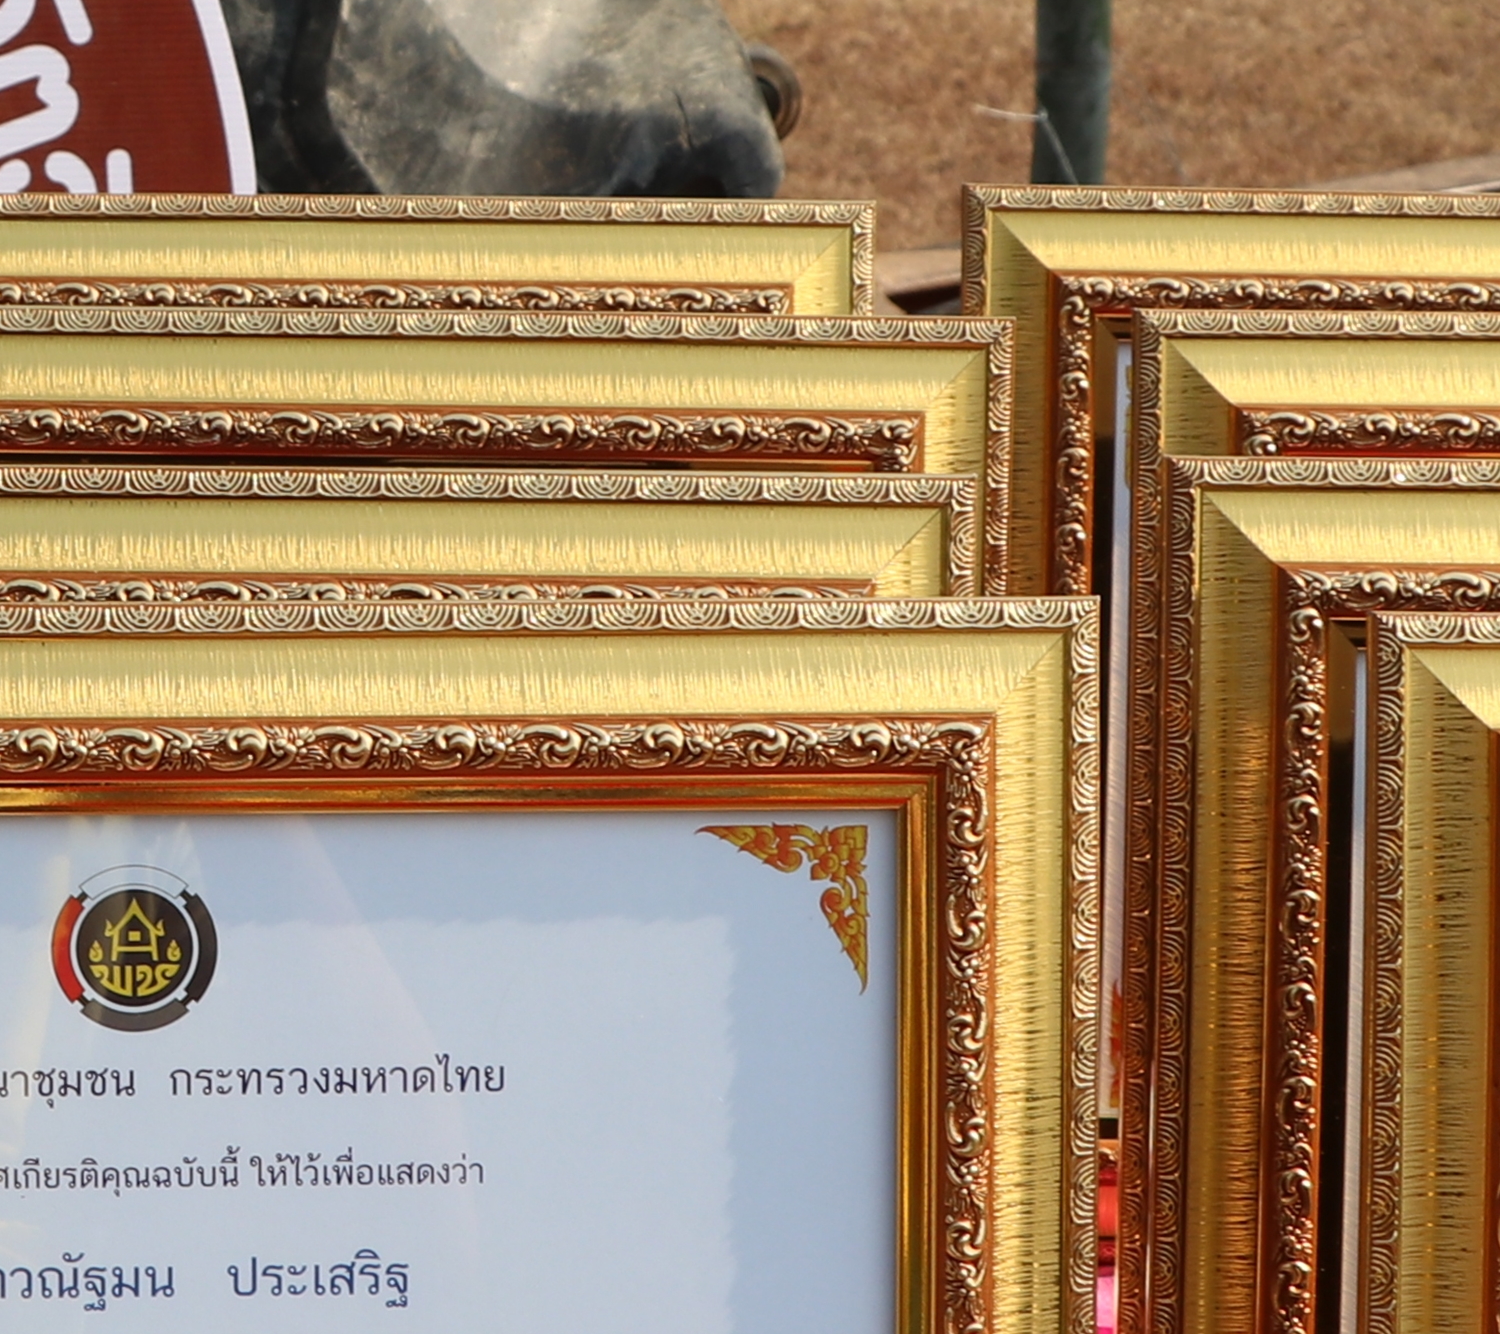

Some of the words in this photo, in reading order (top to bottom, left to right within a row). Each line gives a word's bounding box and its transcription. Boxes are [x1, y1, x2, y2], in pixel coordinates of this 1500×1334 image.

[168, 1052, 505, 1097] กระทรวงมหาดไทย
[248, 1146, 484, 1188] ให้ไว้เพื่อแสดงว่า
[226, 1248, 410, 1309] ประเสริฐ
